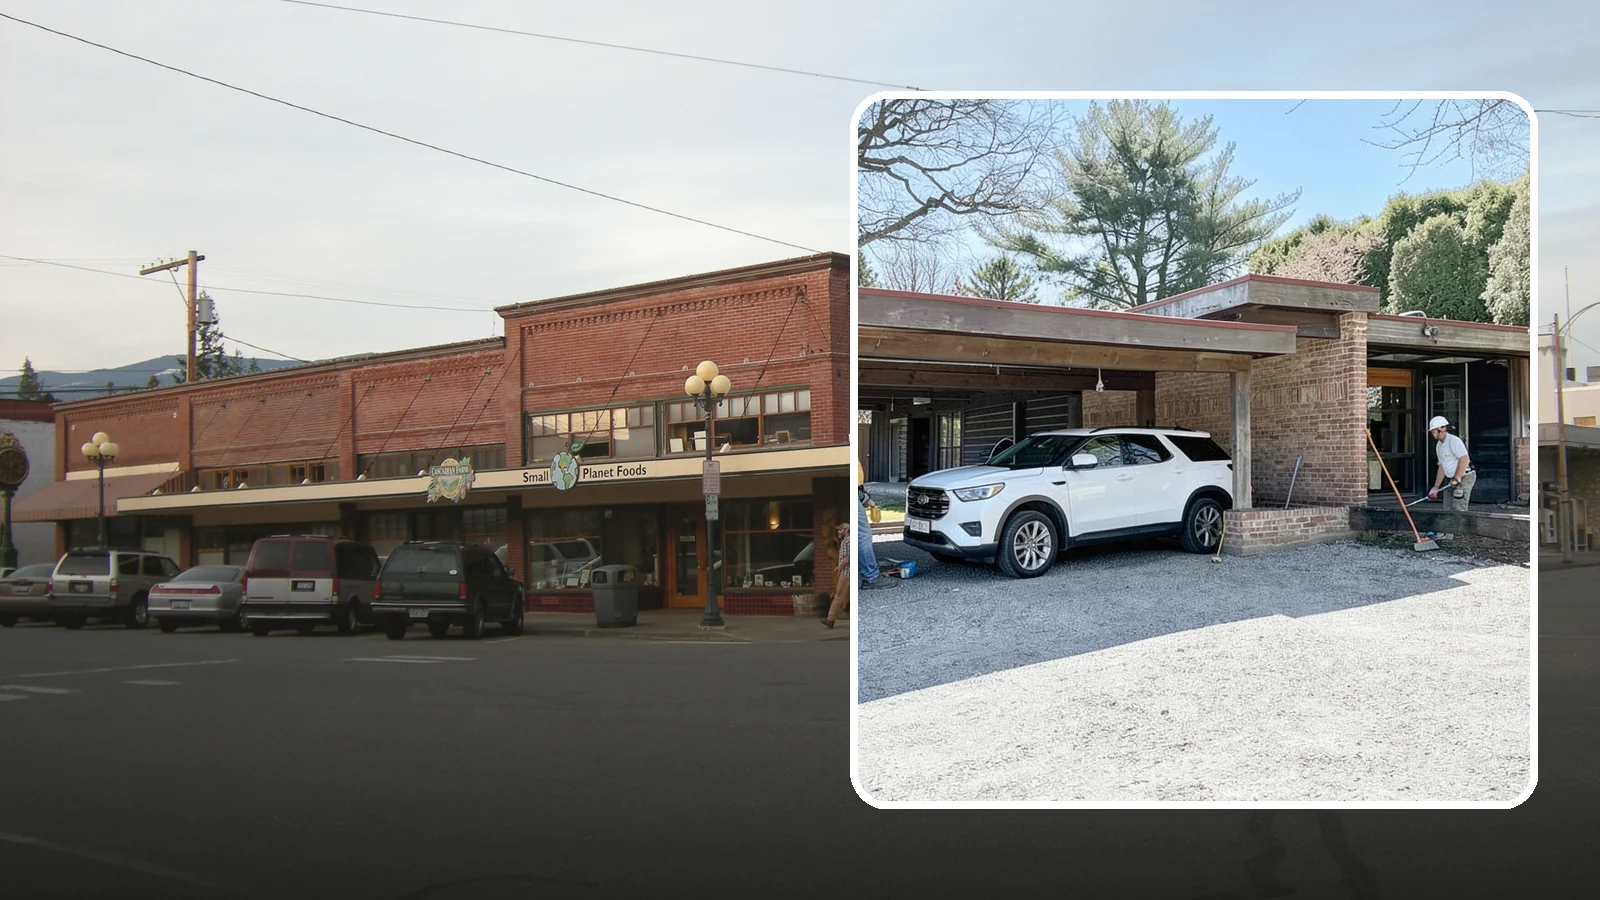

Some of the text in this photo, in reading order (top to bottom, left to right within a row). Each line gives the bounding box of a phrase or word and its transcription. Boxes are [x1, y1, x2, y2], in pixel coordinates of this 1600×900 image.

[522, 464, 647, 483] Small Planet Foods
